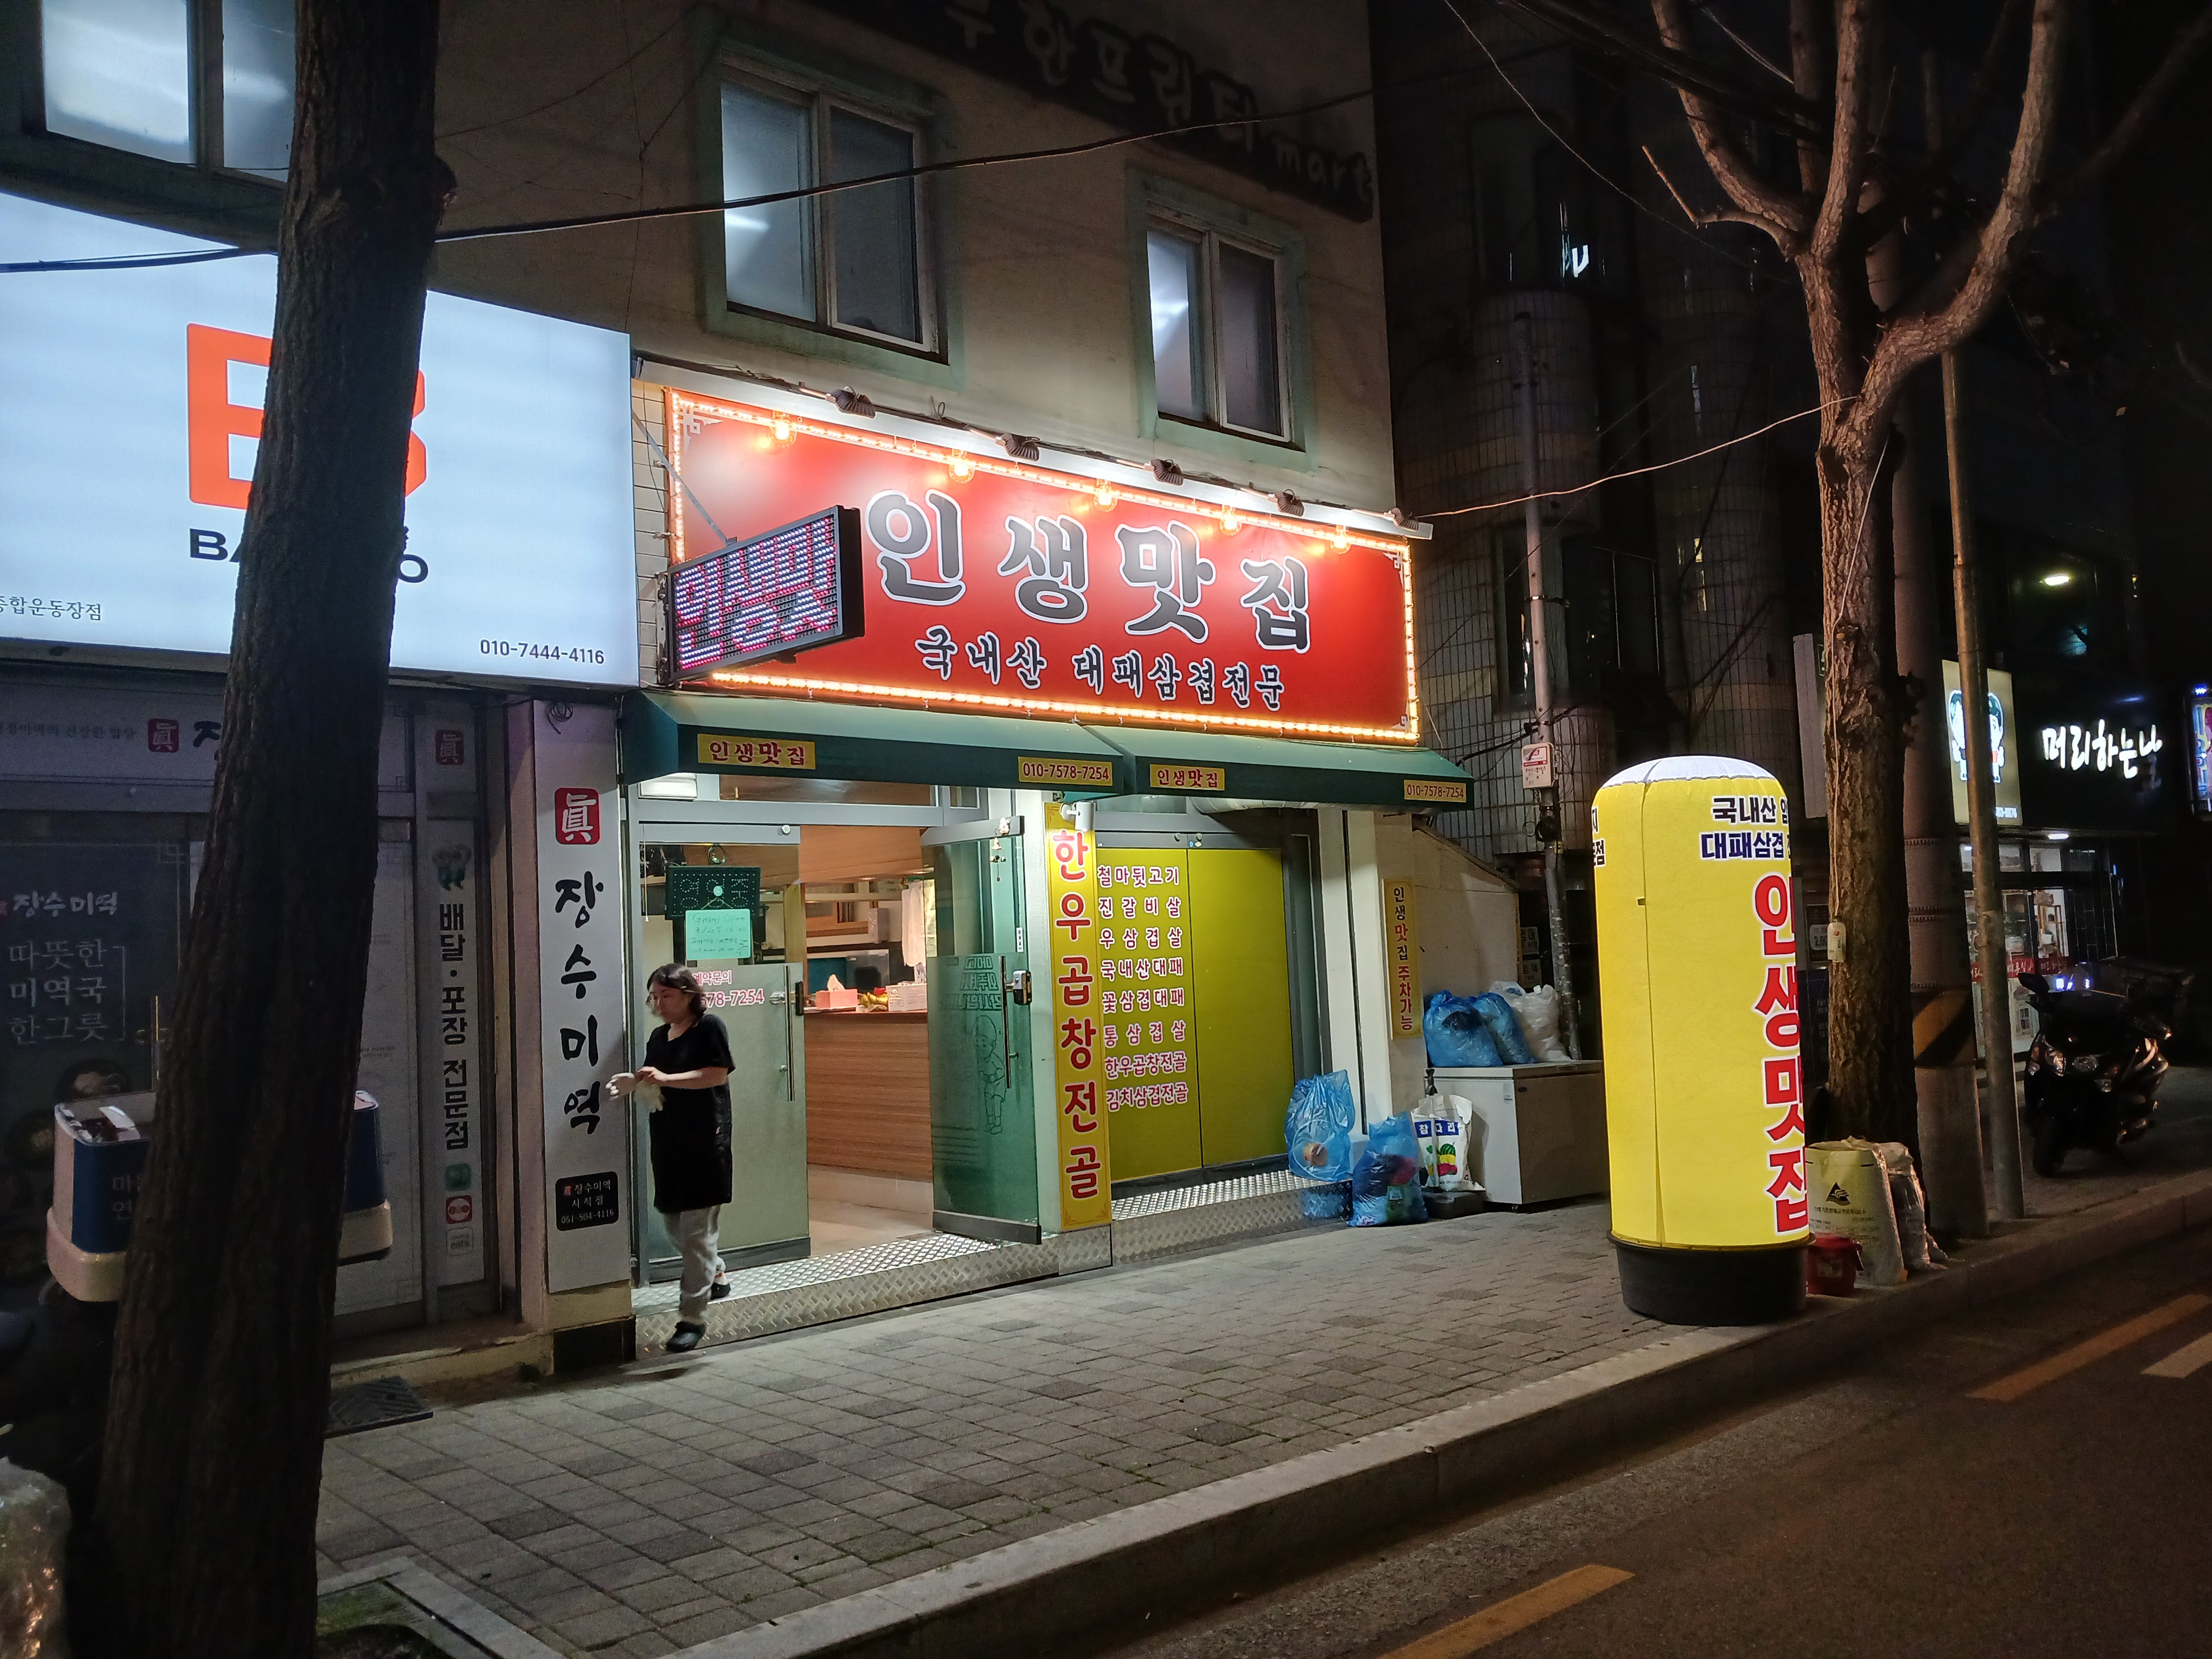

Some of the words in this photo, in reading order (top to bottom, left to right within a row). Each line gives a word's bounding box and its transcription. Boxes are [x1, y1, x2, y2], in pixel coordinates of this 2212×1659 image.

[865, 487, 1311, 653] 인생맛집
[480, 639, 606, 665] 010-7444-4116
[914, 625, 1048, 689] 국내산
[1072, 643, 1285, 712] 대패삼겹전문
[709, 741, 806, 767] 인생맛집
[1023, 762, 1110, 781] 010-7578-7254
[1156, 769, 1219, 788] 인생맛집
[1406, 783, 1464, 799] 010-7578-7254
[1712, 796, 1777, 824] 국내산
[1700, 831, 1785, 859] 대패삼겹
[1097, 864, 1180, 888] 철마뒷고기
[13, 890, 118, 918] 장수미역
[1392, 886, 1410, 962] 인생맛집
[1101, 956, 1184, 981] 국내산대패
[8, 976, 107, 1007] 미역국
[555, 870, 603, 1135] 장수미역
[1397, 965, 1413, 1031] 주차가능
[1052, 829, 1102, 1199] 한우곱창전골
[8, 1012, 108, 1045] 한그릇
[1104, 1050, 1187, 1079] 한우곱창전골
[442, 1059, 469, 1150] 전문점
[1105, 1081, 1189, 1113] 김치삼겹전골
[574, 1179, 611, 1195] 장수미역
[561, 1208, 614, 1224] 051-504-4116
